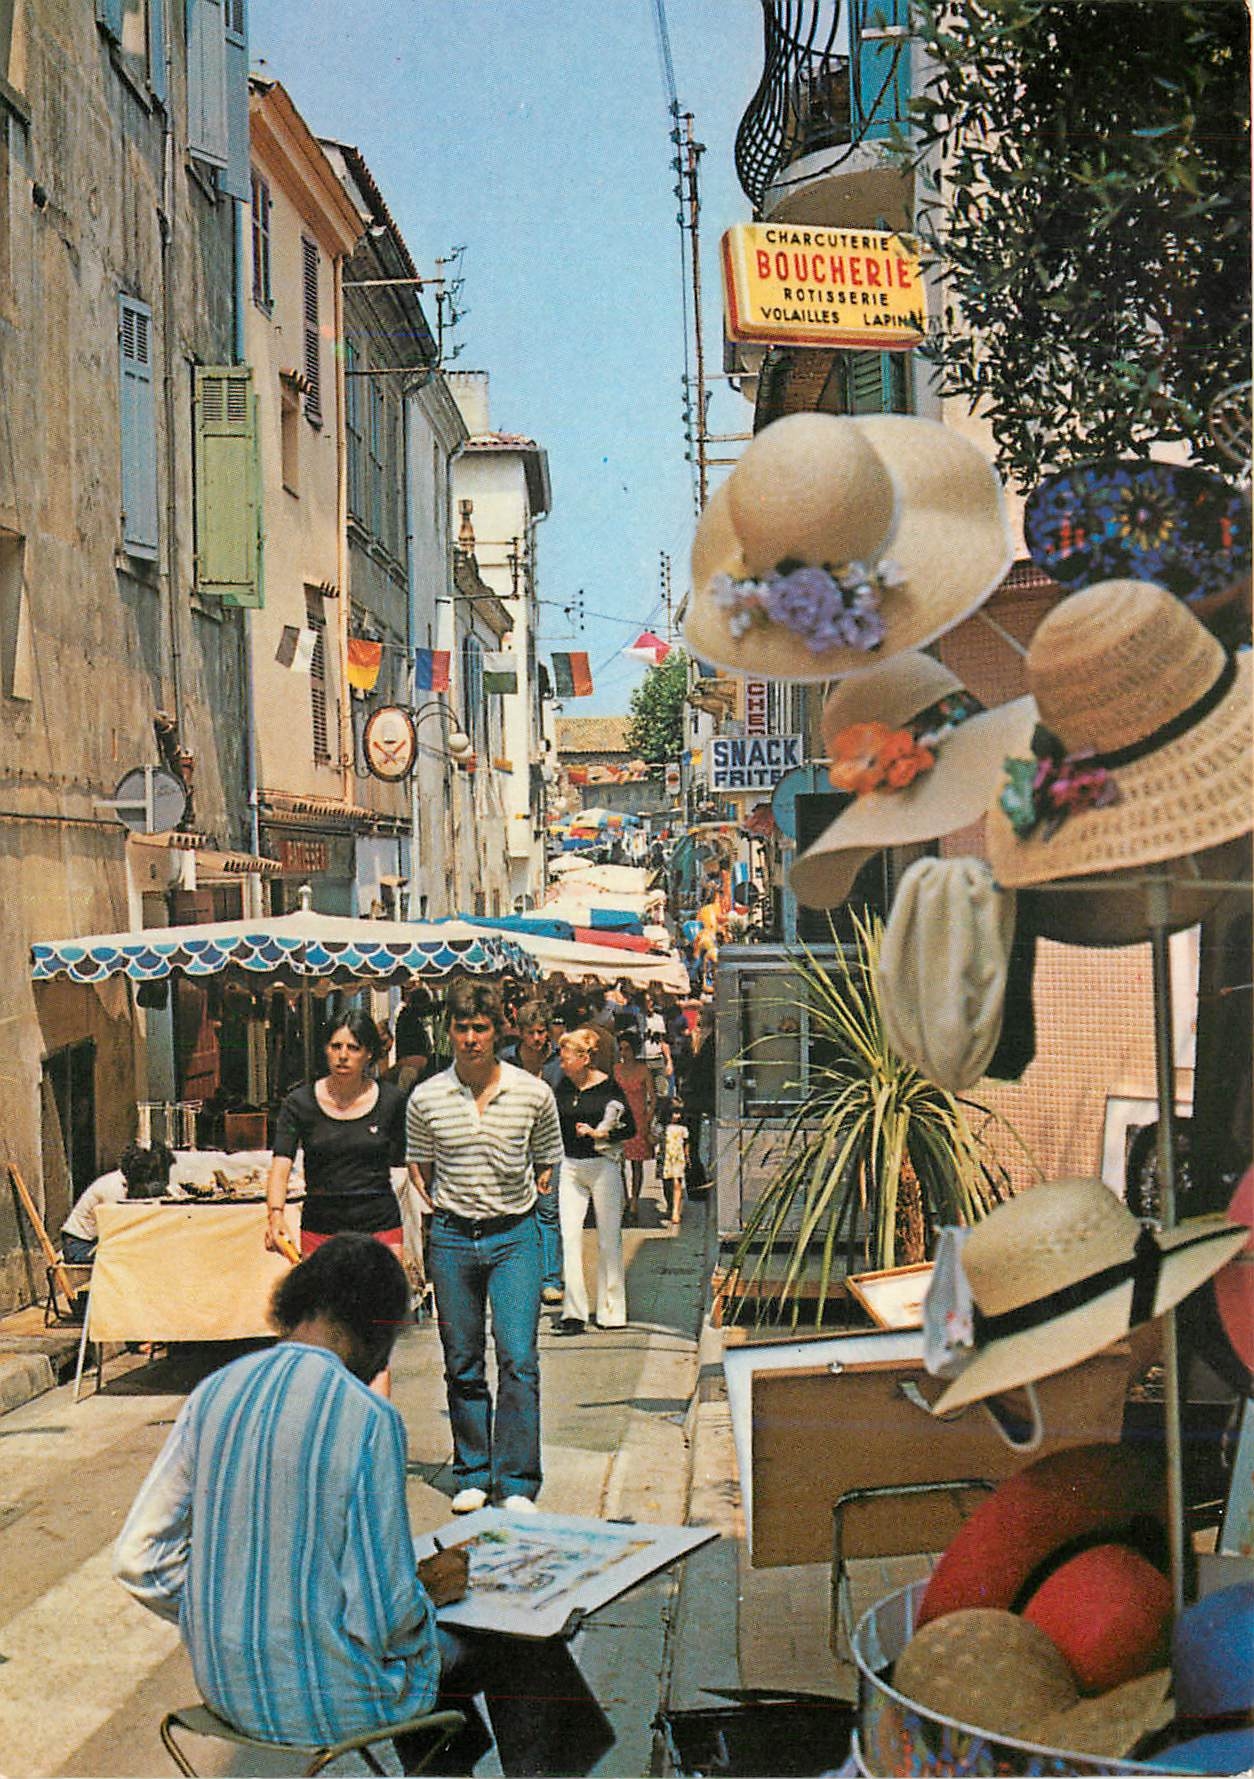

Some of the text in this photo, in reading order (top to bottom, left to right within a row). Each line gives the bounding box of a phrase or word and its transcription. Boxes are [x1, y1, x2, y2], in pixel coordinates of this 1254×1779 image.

[766, 230, 889, 251] CHARCUTERIE
[755, 249, 912, 289] BOUCHERIE
[784, 287, 889, 307] ROTISSERIE
[760, 306, 840, 324] VOLAILLES
[713, 739, 799, 767] SNACK
